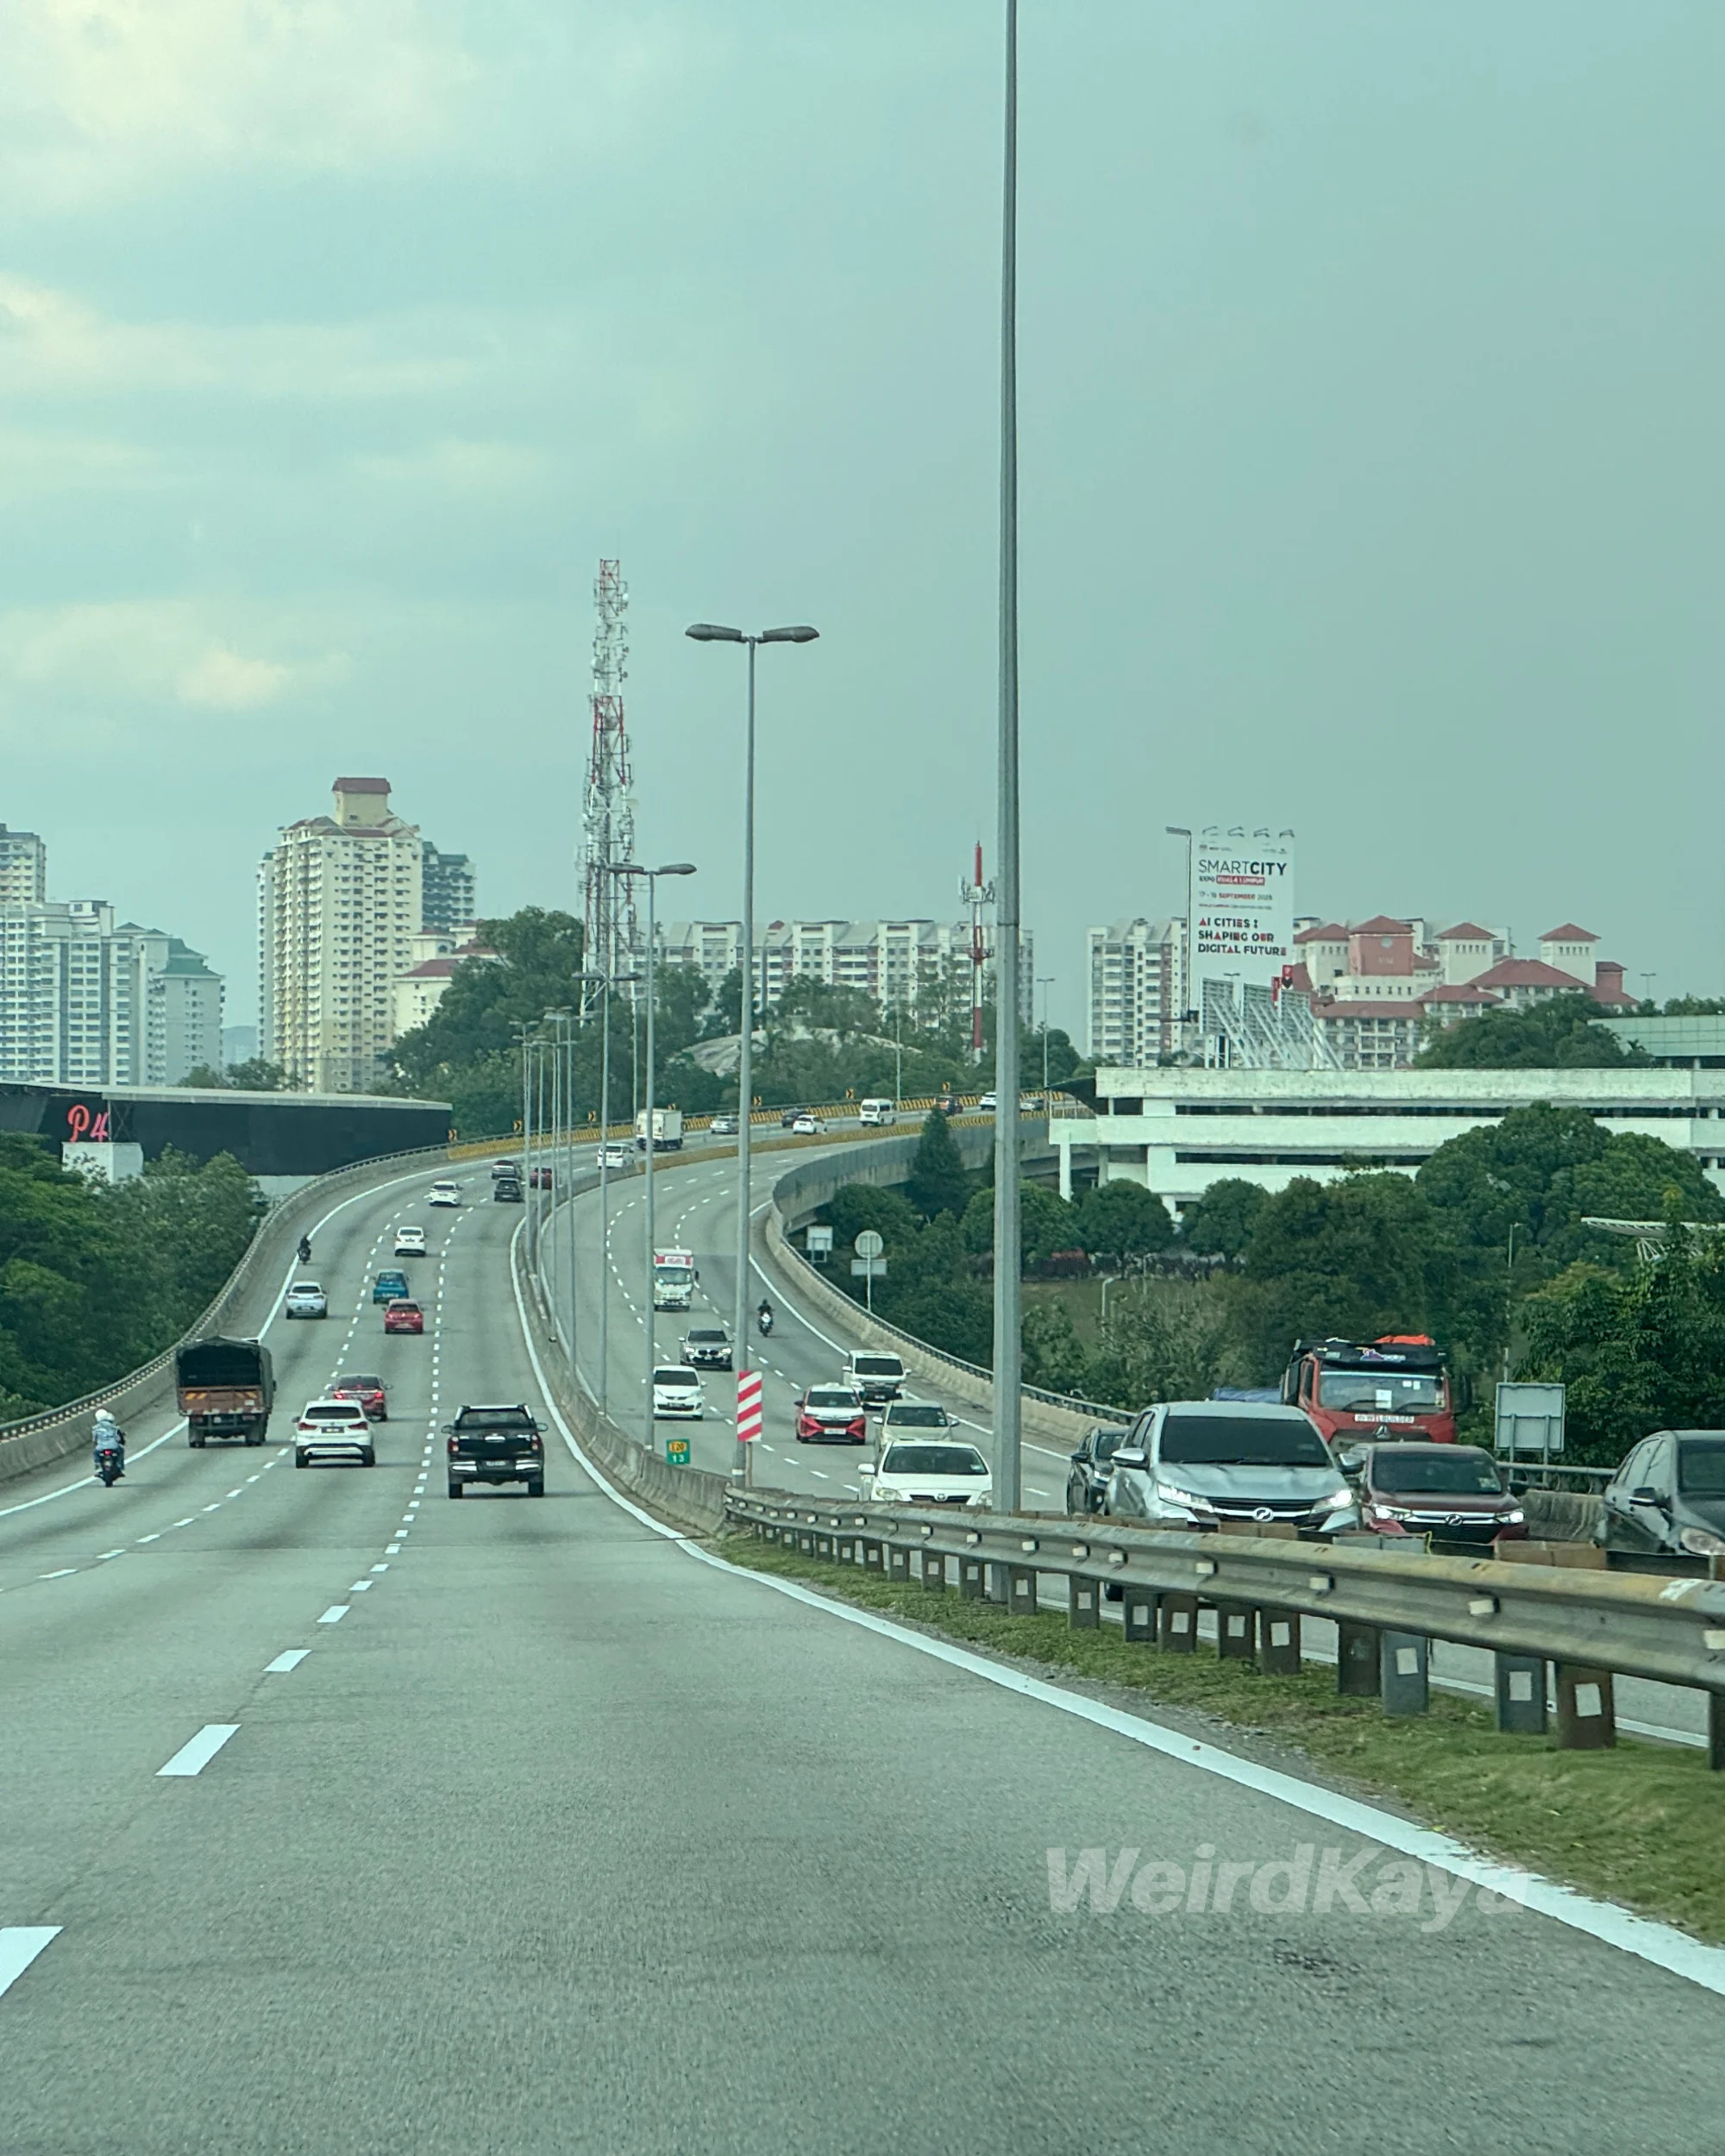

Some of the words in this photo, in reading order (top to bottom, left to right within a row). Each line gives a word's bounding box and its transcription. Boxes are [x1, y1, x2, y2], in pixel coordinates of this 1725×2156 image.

[1198, 859, 1287, 875] SMARTCITY
[1199, 918, 1211, 926] AI
[1214, 918, 1251, 928] CITIES
[1198, 931, 1248, 942] SHAPING
[1251, 933, 1274, 943] OUR
[1198, 943, 1240, 954] DIGITAL
[1244, 945, 1287, 956] FUTURE
